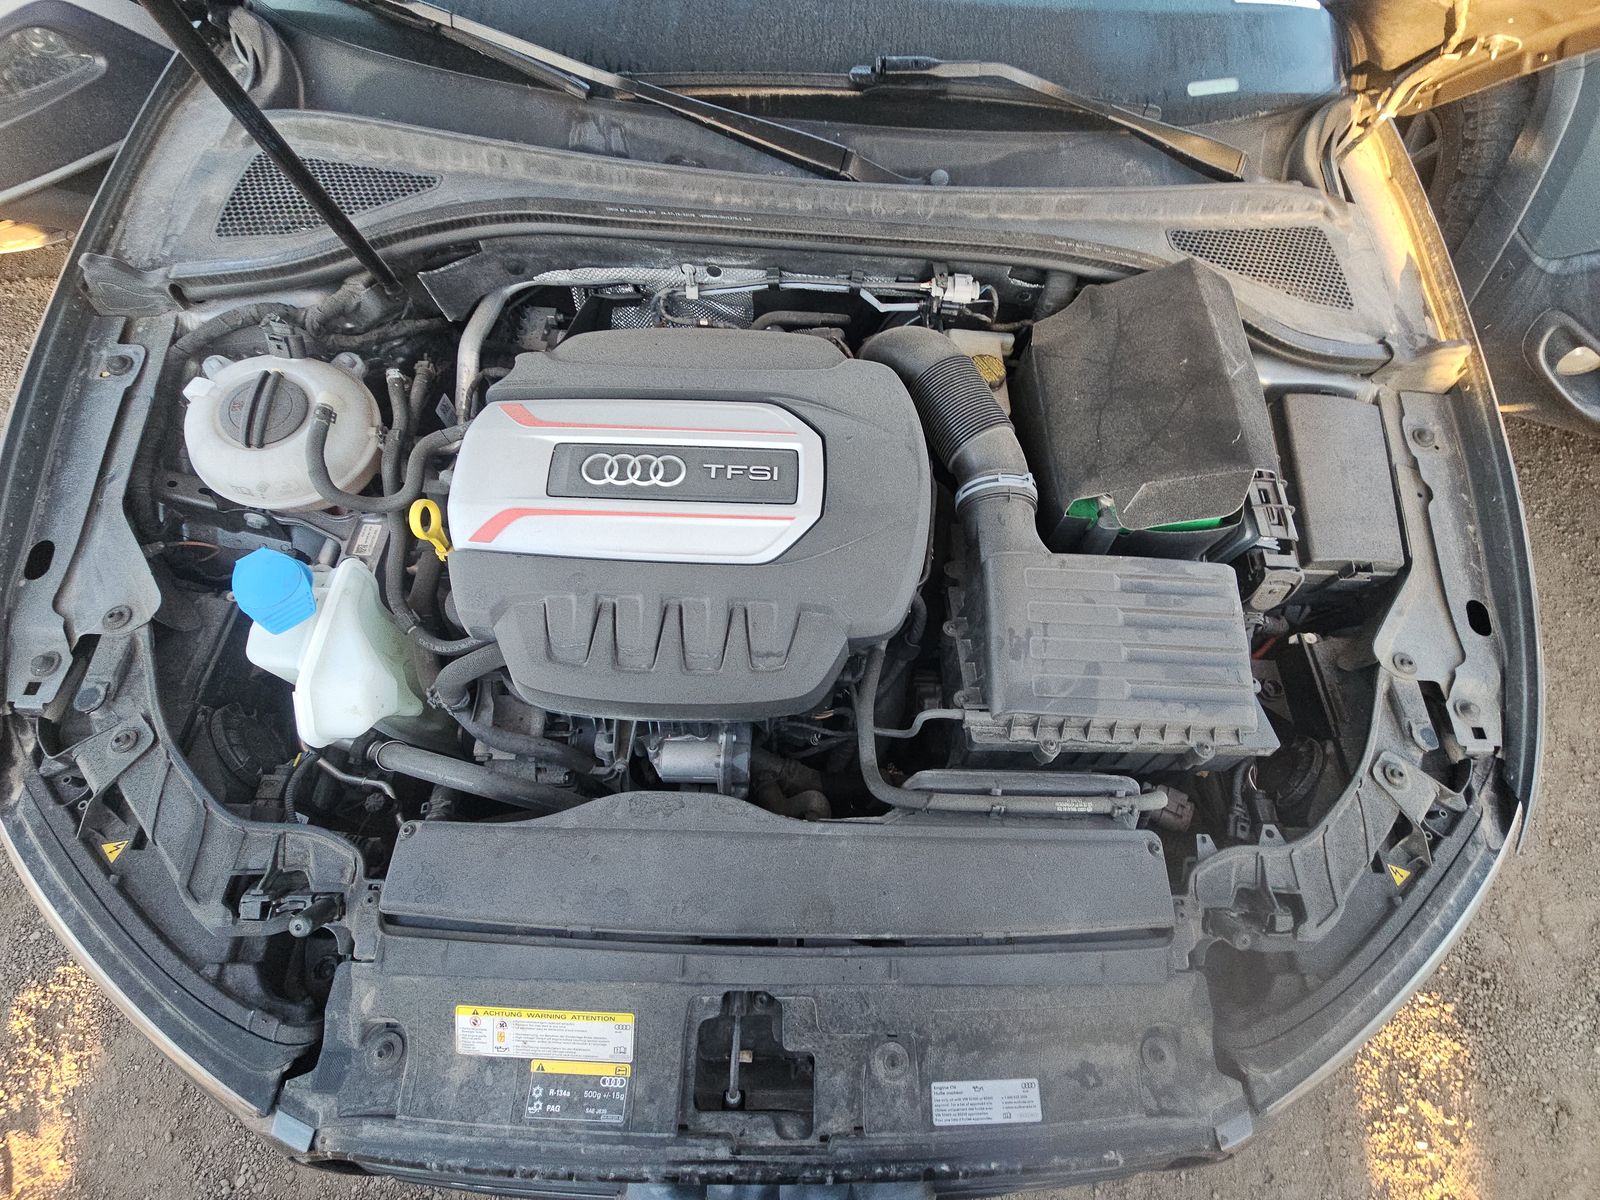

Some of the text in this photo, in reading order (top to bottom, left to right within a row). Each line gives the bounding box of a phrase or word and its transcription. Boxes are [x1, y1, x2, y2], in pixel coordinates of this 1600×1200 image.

[703, 464, 778, 480] TFSI
[483, 1010, 616, 1022] ACHTUNG WARNING ATTENTION
[549, 1088, 571, 1097] R-134a
[584, 1090, 601, 1100] 500g
[612, 1091, 625, 1101] 15g
[546, 1104, 561, 1113] PAG
